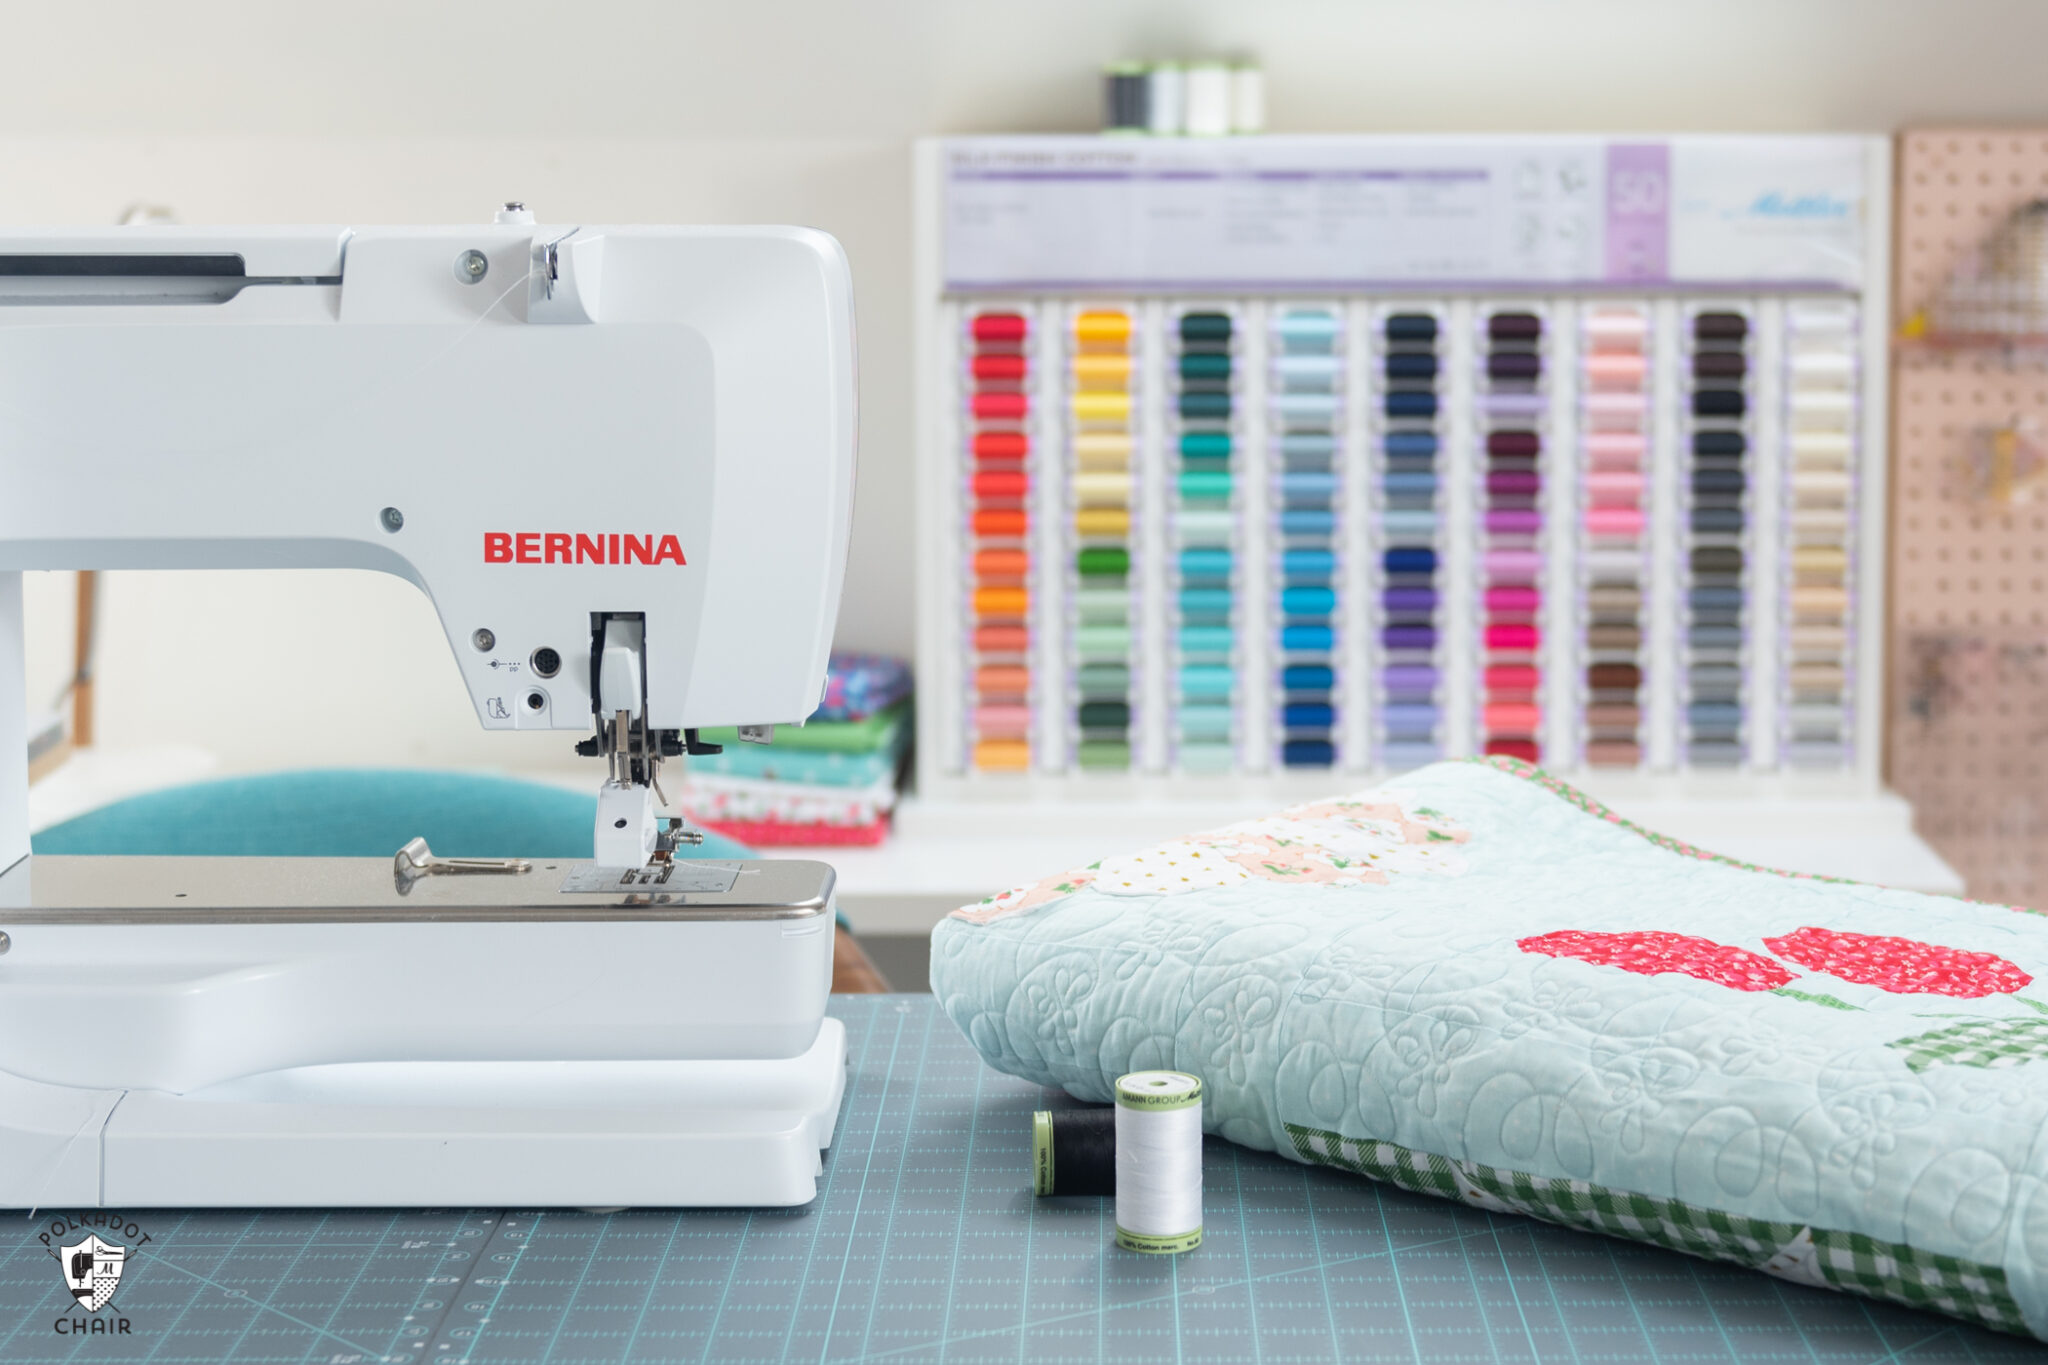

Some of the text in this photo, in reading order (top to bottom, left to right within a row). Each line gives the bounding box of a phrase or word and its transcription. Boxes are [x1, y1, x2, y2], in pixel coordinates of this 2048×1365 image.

[484, 532, 687, 566] BERNINA
[1147, 1094, 1181, 1105] GROUP
[1138, 1243, 1160, 1251] Cotton
